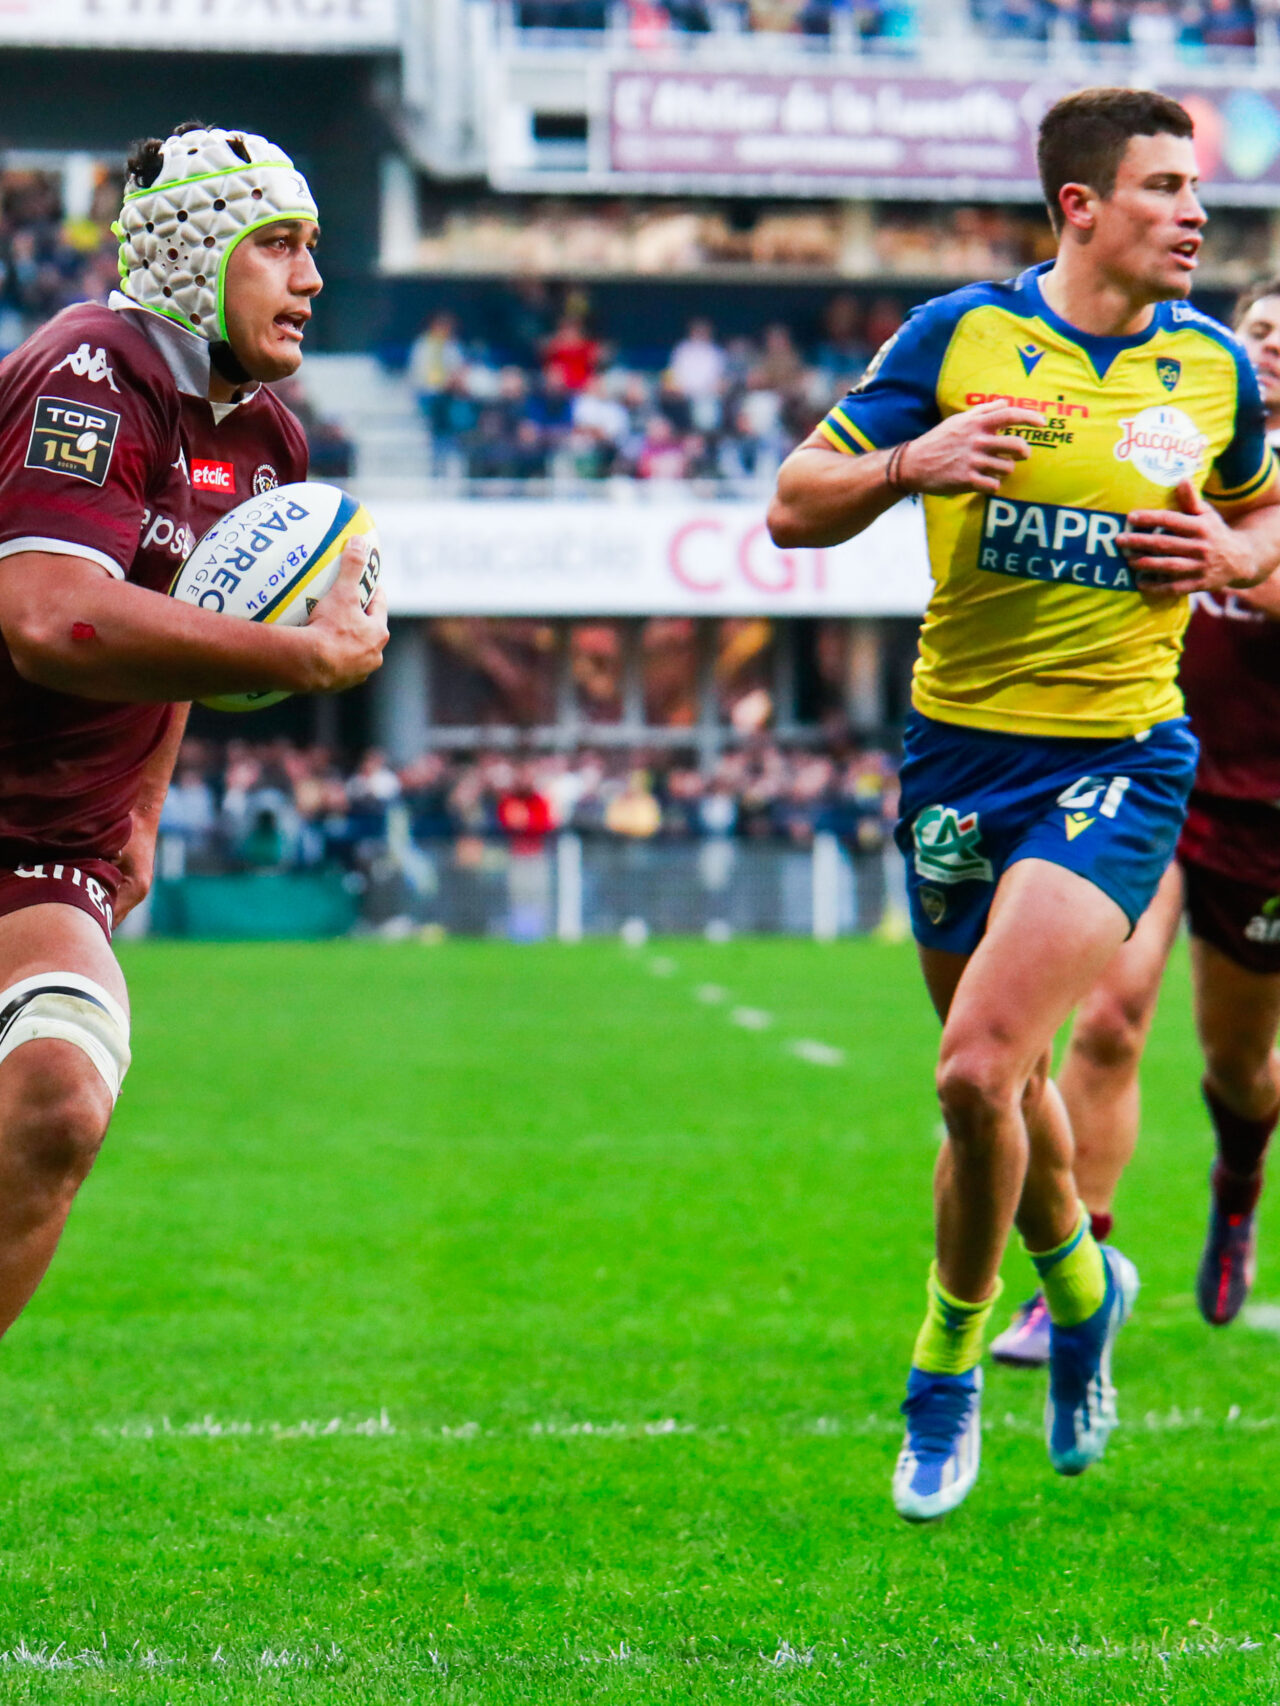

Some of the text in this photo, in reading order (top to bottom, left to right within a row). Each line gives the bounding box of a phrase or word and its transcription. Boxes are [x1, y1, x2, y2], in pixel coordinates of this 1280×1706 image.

[47, 407, 106, 429] TOP
[965, 393, 1089, 418] omerin
[43, 440, 97, 473] 14
[1116, 421, 1206, 462] Jacquet
[193, 465, 230, 486] etclic
[187, 494, 286, 597] RECYCLAGE
[984, 498, 1132, 558] PAPR
[199, 500, 310, 613] PAPREC
[668, 518, 826, 594] CGI
[981, 547, 1132, 587] RECYCLA
